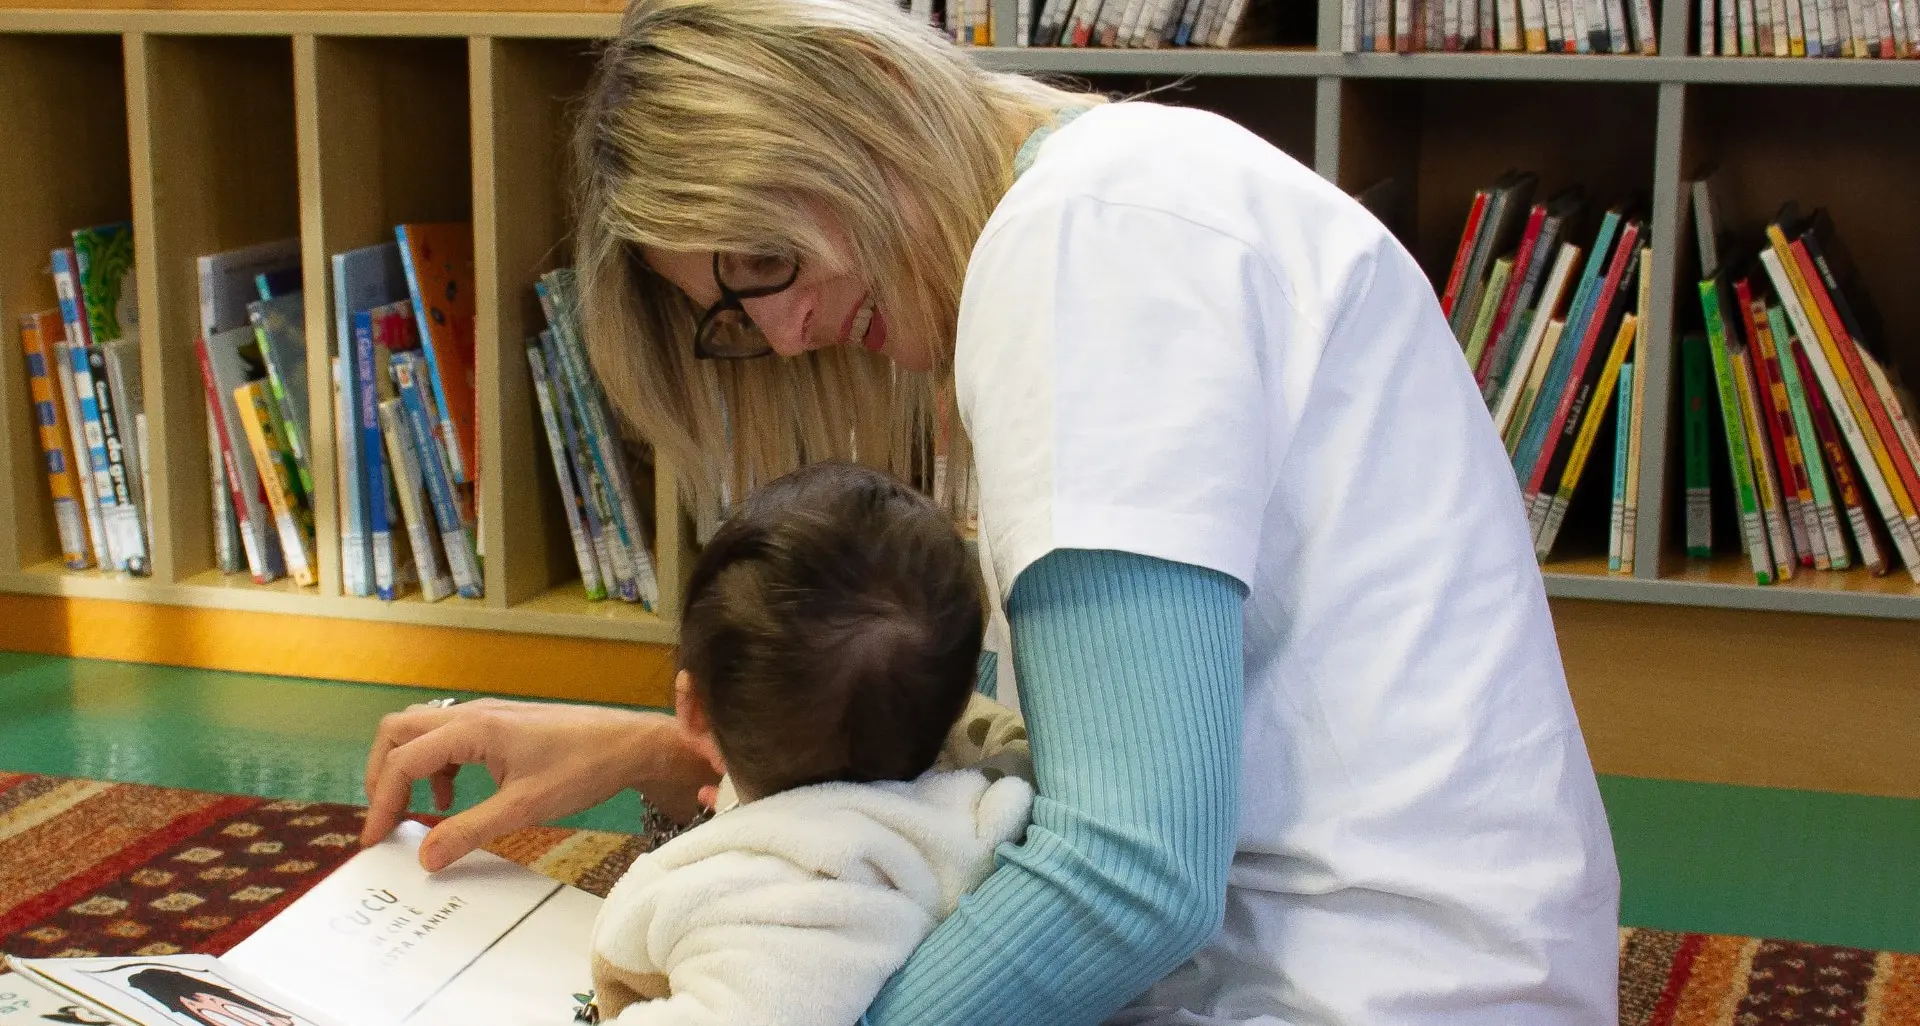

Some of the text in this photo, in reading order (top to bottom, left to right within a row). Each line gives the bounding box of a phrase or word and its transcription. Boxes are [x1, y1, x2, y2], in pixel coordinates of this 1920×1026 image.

[107, 436, 122, 462] da
[109, 463, 129, 504] gran
[328, 887, 399, 934] CUCÙ
[386, 916, 410, 934] CHI
[402, 905, 424, 915] È
